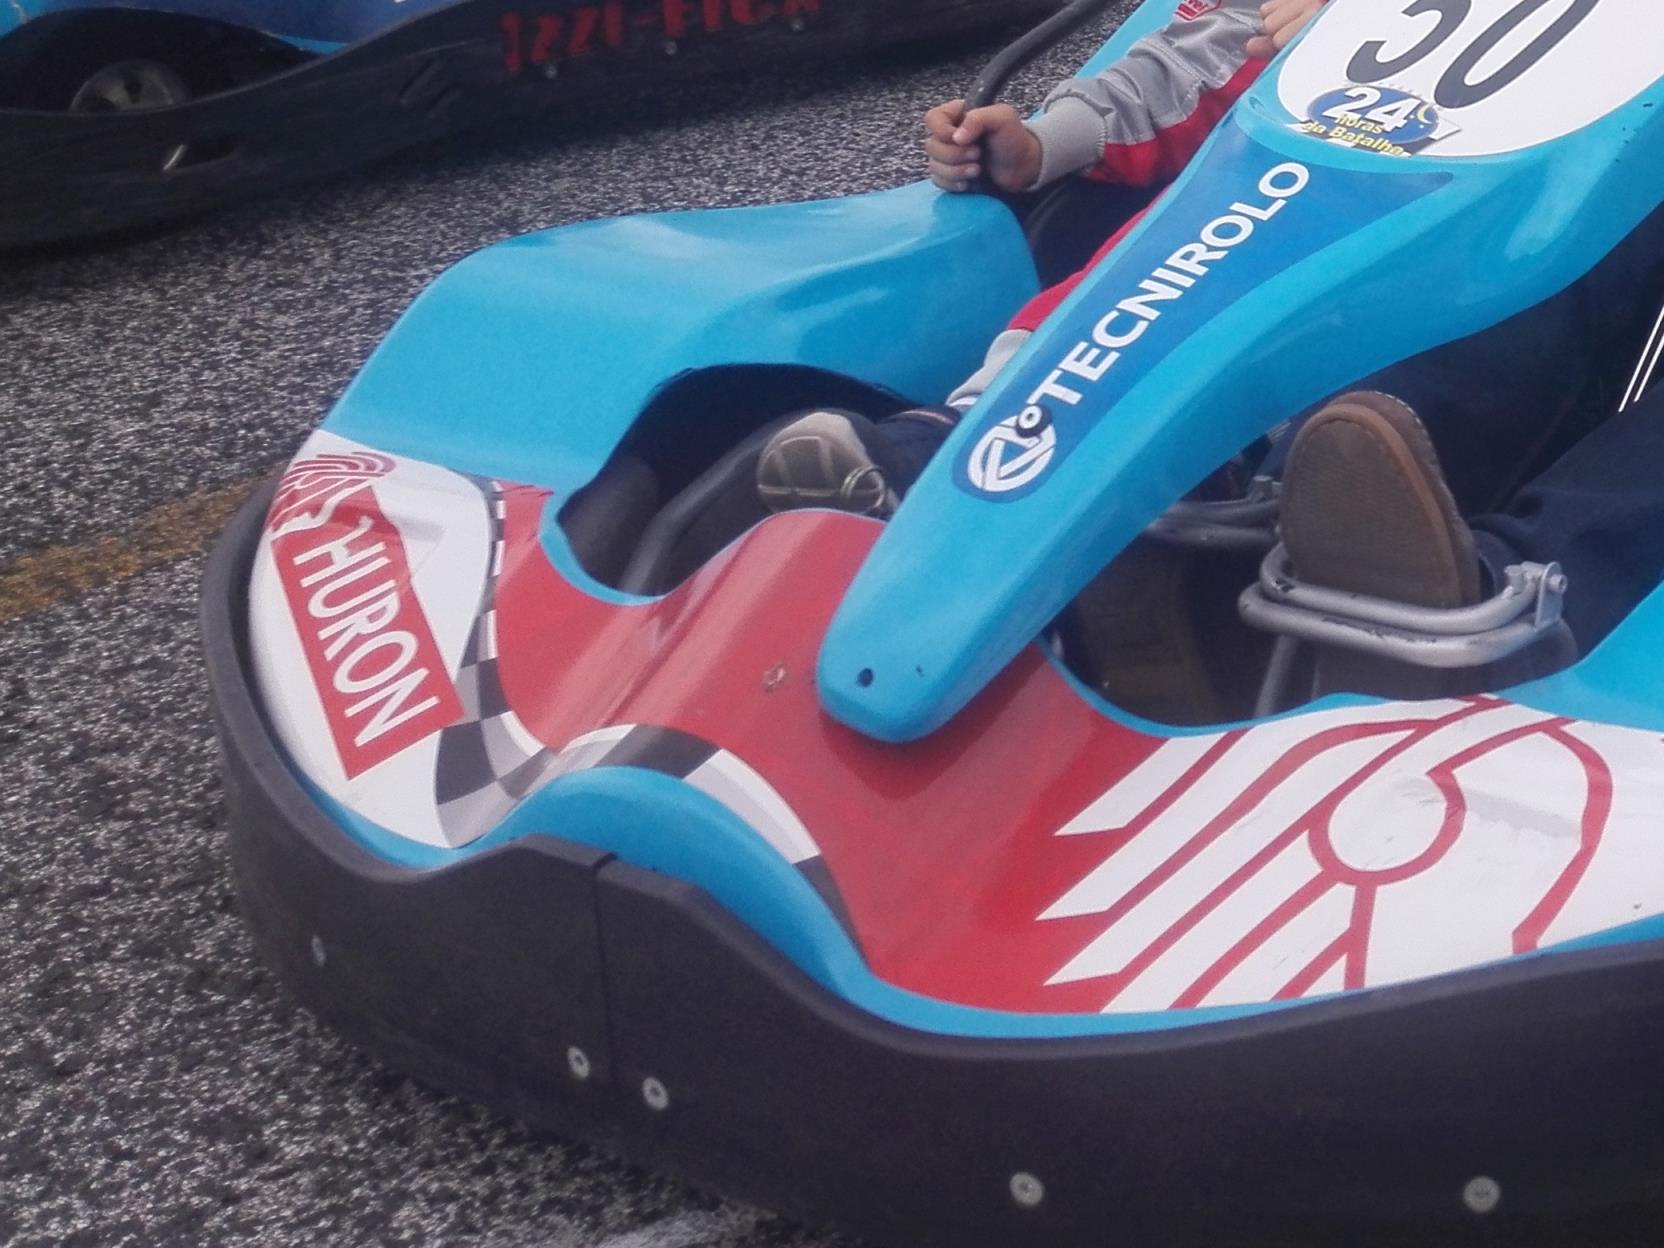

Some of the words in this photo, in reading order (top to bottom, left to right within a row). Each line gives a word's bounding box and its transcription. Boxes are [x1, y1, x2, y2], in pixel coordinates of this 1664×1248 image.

[1302, 121, 1327, 134] da
[1328, 126, 1405, 156] Batalha
[1321, 86, 1422, 132] 24
[1030, 161, 1311, 406] TECNIROLO
[292, 515, 441, 748] HURON
